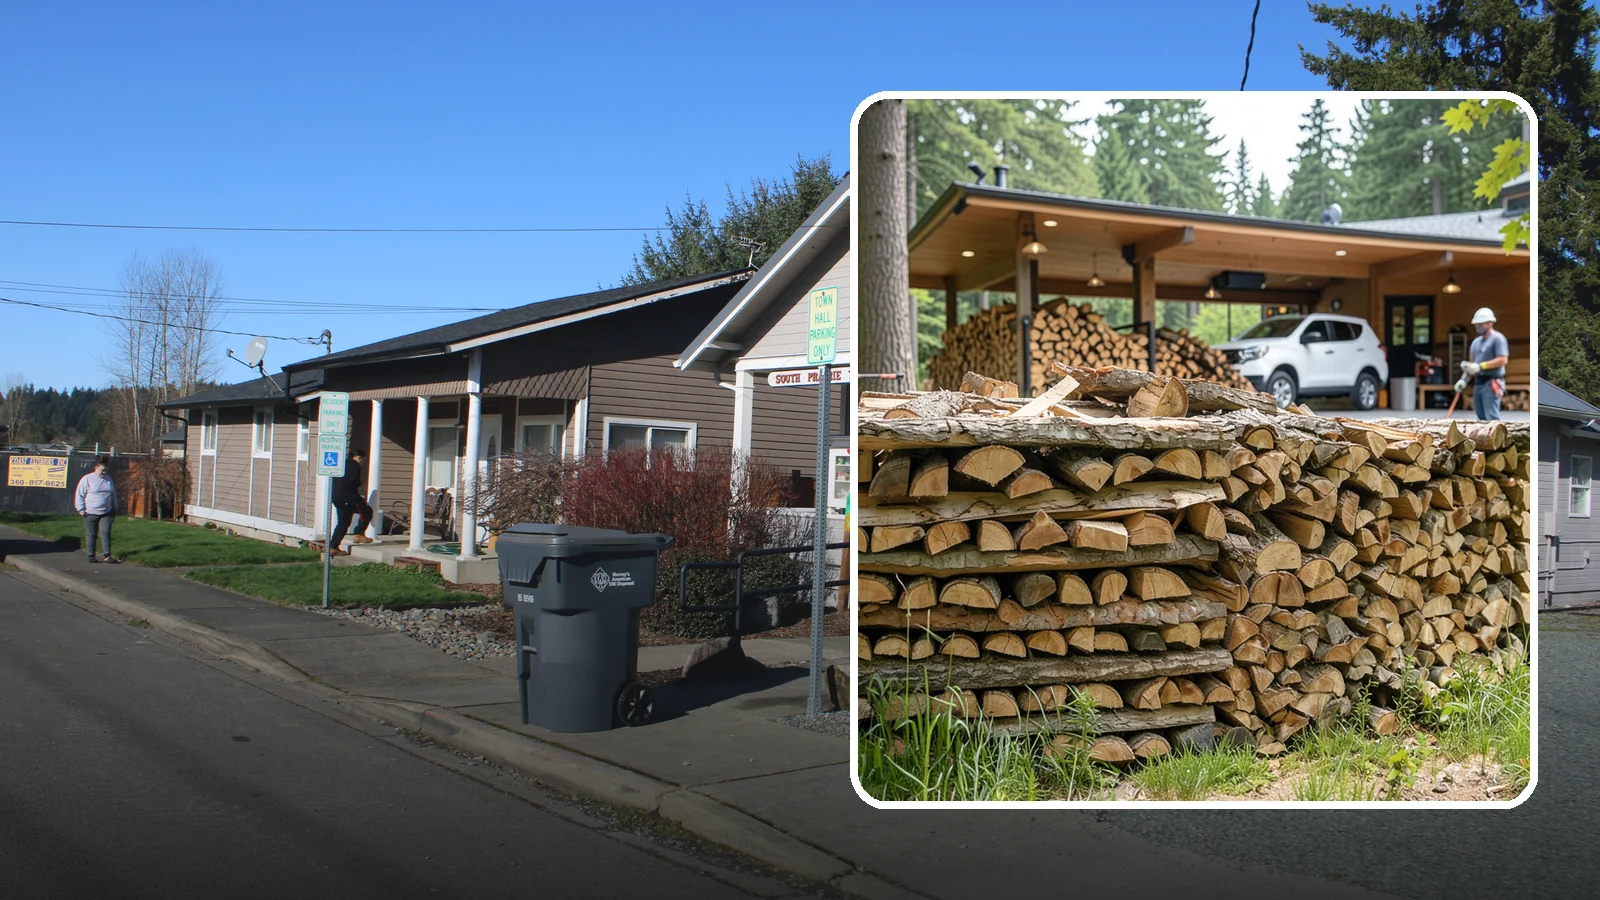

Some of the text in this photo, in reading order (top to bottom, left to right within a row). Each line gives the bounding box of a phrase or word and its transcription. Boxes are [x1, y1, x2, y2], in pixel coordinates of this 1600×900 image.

[815, 294, 833, 308] TOWN
[815, 311, 831, 324] HALL
[810, 326, 836, 340] PARKING
[813, 344, 831, 357] ONLY
[775, 373, 801, 384] SOUTH
